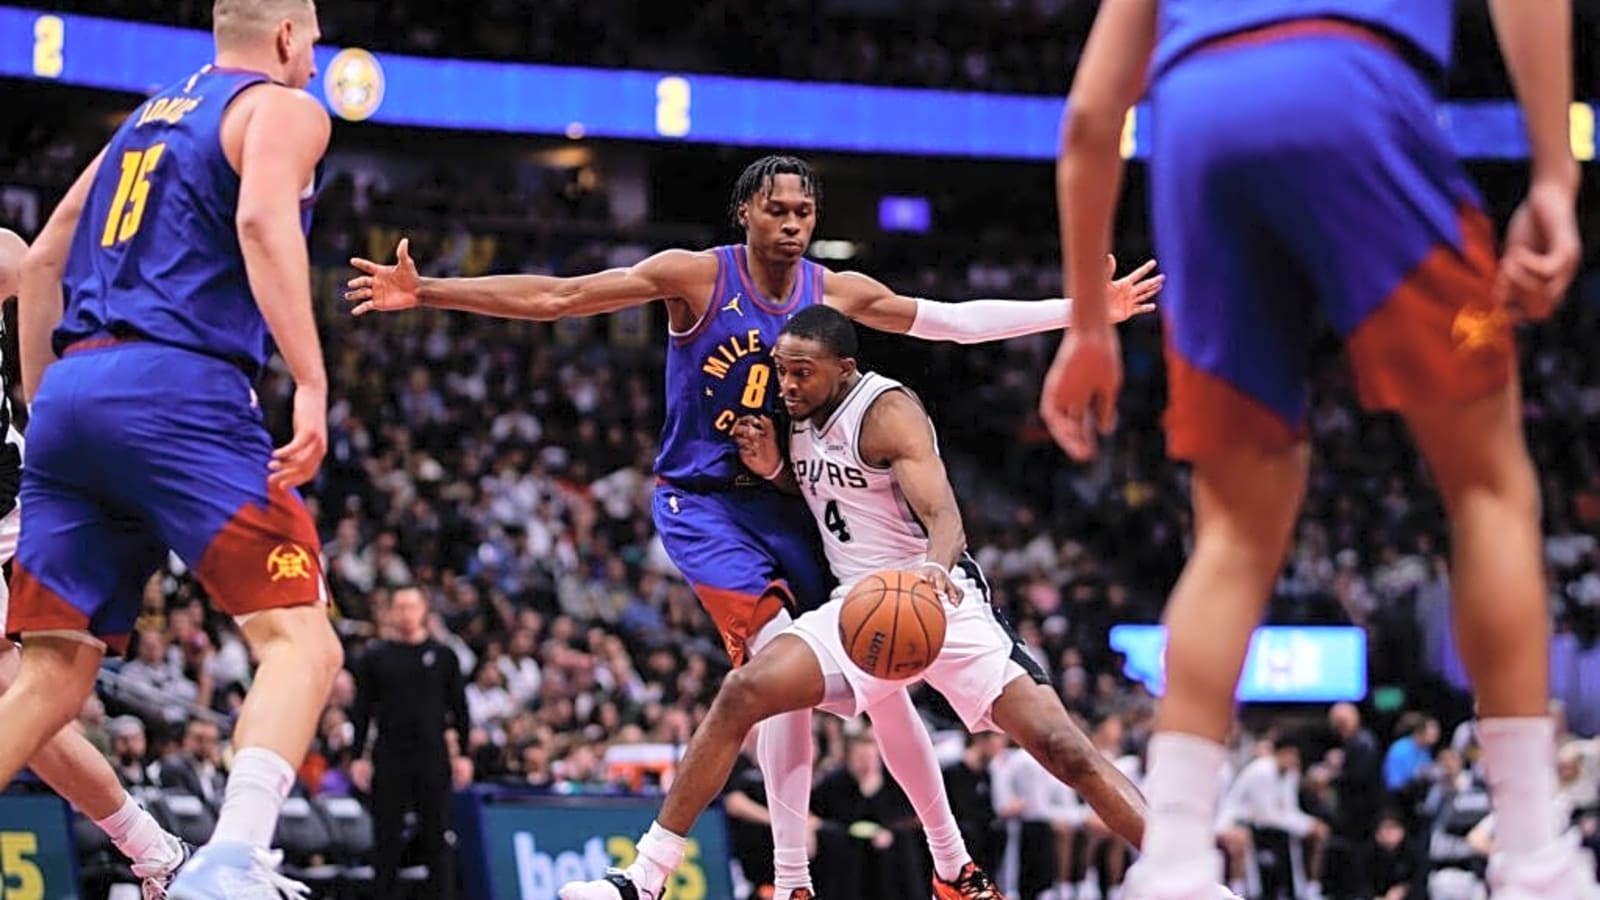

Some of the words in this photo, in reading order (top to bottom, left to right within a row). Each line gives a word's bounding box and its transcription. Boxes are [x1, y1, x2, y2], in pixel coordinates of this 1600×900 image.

[33, 15, 64, 78] 2
[102, 142, 166, 248] 15
[703, 329, 761, 379] MILE
[741, 363, 770, 408] 8
[825, 499, 850, 543] 4
[0, 831, 45, 900] 5
[513, 831, 707, 900] bet35
